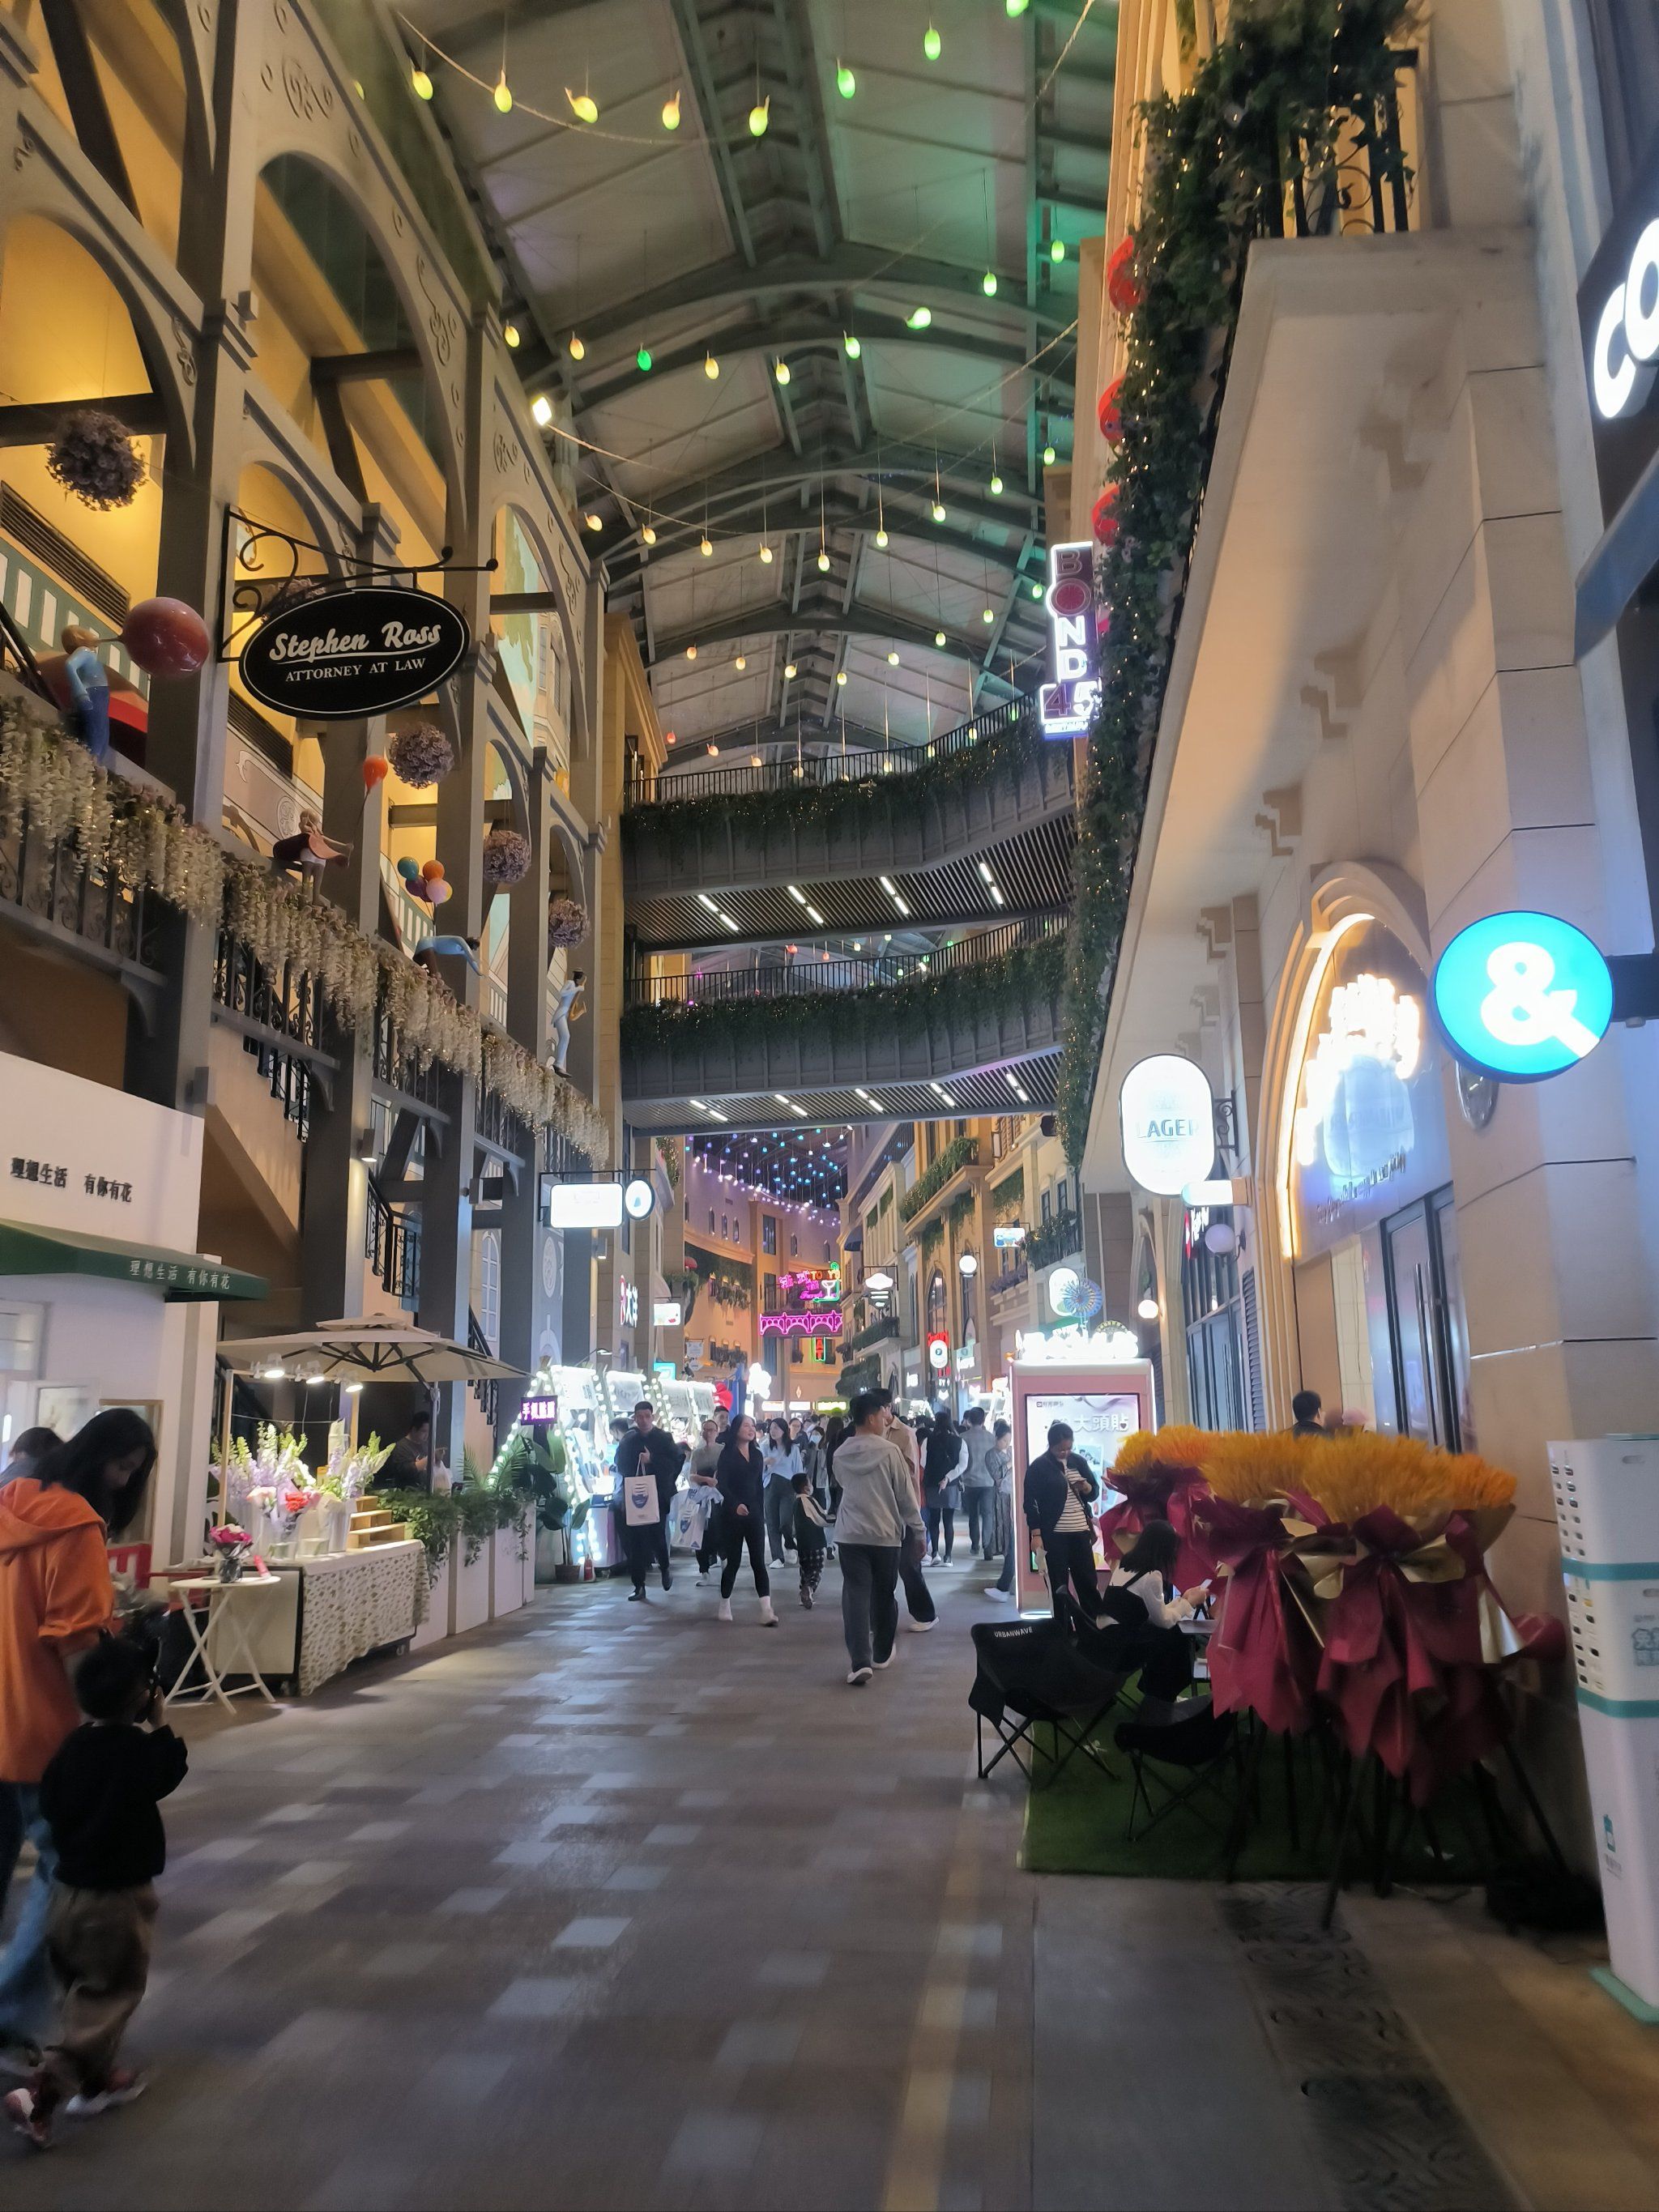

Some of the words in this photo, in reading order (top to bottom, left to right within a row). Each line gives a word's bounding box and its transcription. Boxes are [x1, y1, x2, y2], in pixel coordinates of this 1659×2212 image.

[269, 628, 370, 663] Stephen
[381, 620, 442, 650] Ross
[285, 664, 362, 682] ATTORNEY
[369, 662, 389, 674] AT
[394, 658, 426, 671] LAW
[1045, 681, 1096, 717] 45
[11, 1157, 68, 1188] 理想生活
[84, 1174, 133, 1203] 有你有花
[130, 1259, 178, 1281] 理想生活
[187, 1267, 231, 1289] 有你有花
[994, 1626, 1033, 1638] URBANWAVE
